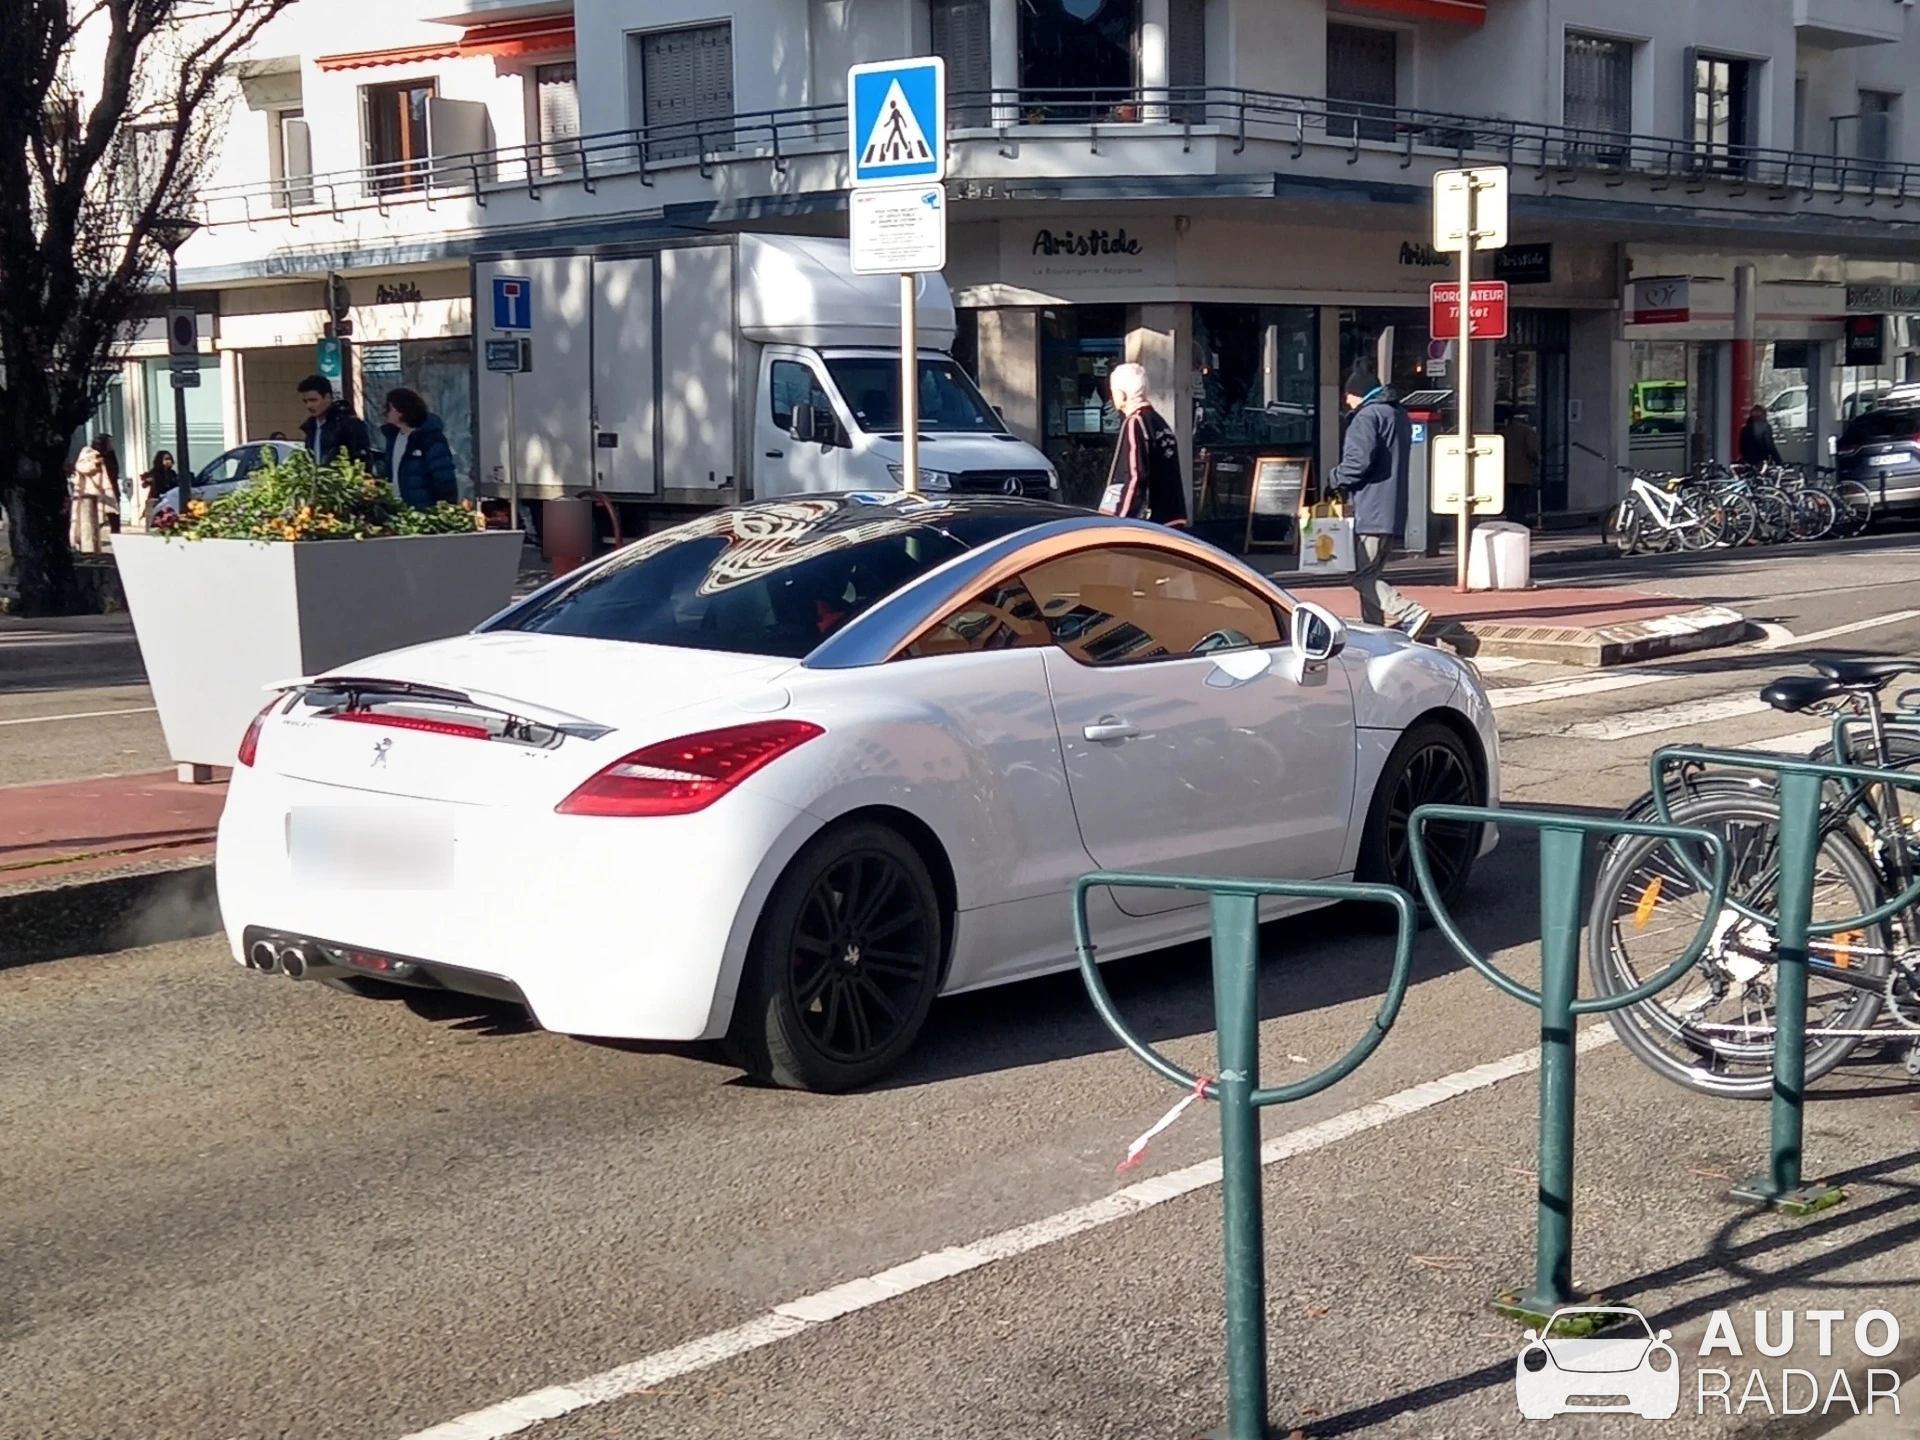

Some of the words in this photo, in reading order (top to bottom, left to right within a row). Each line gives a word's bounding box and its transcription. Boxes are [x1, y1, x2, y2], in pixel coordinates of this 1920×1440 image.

[1032, 228, 1143, 256] Aristide
[1434, 289, 1504, 303] HOROATEUR
[1449, 306, 1489, 318] Tiket
